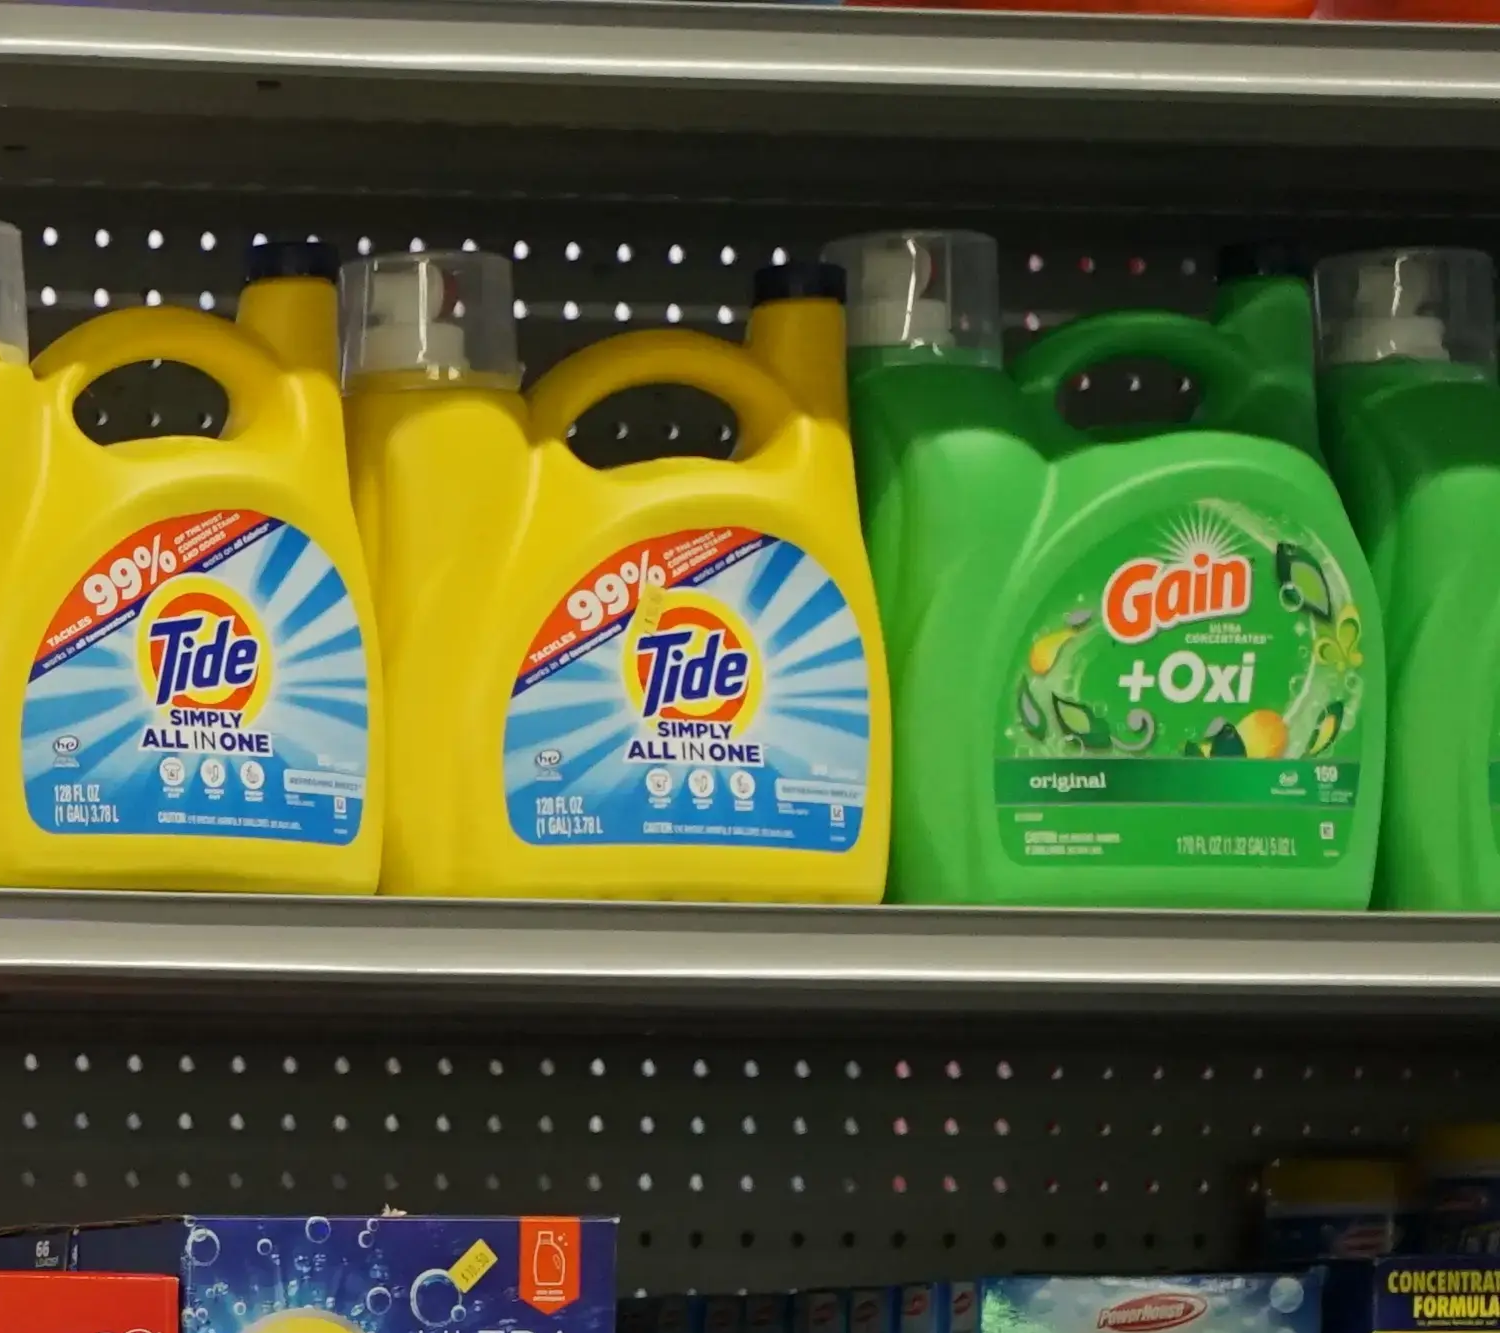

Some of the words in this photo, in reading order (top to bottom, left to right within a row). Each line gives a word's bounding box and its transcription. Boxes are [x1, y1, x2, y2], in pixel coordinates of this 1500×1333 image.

[83, 534, 177, 615] 99%
[1105, 552, 1252, 641] Gain
[150, 616, 259, 705] Tide
[636, 630, 749, 718] Tide
[170, 708, 243, 729] SIMPLY
[657, 721, 733, 738] SIMPLY
[142, 729, 189, 749] ALL
[194, 730, 215, 749] IN
[219, 732, 270, 752] ONE
[627, 740, 677, 760] ALL
[682, 742, 704, 761] IN
[709, 744, 761, 764] ONE
[1029, 773, 1106, 793] original
[1412, 1295, 1500, 1319] FORMULA
